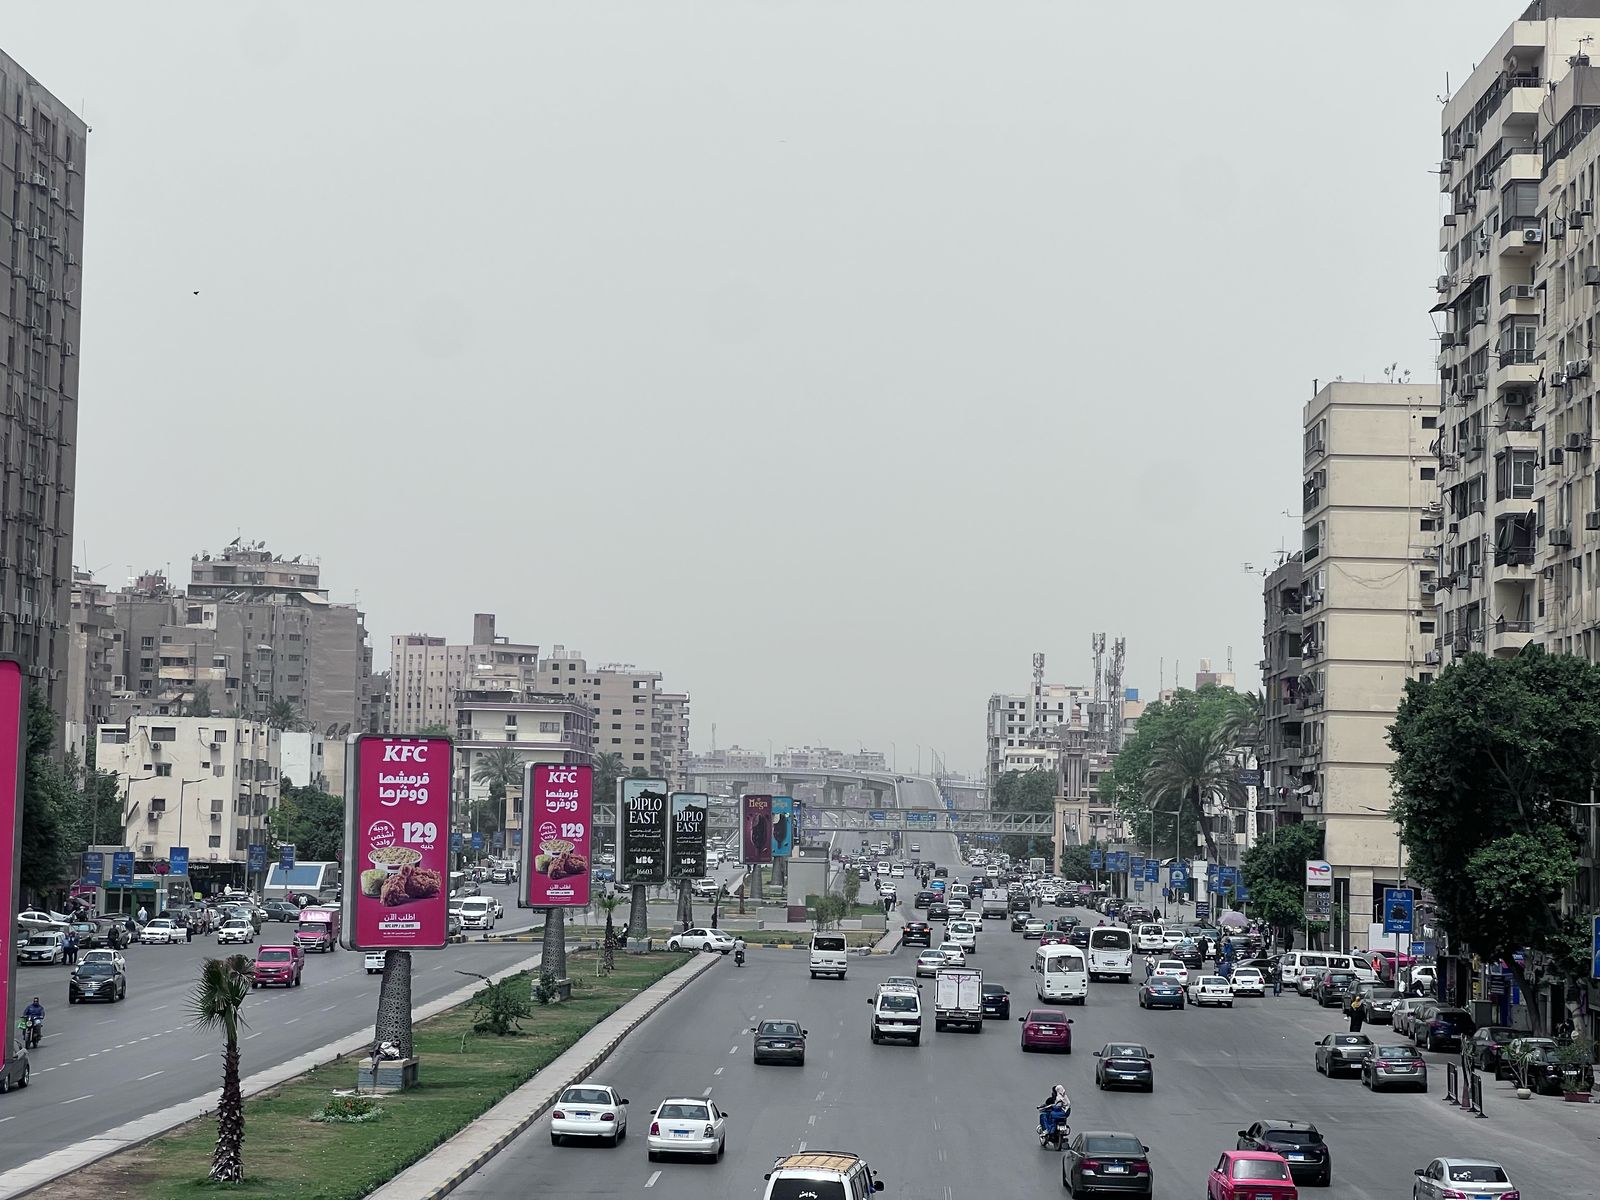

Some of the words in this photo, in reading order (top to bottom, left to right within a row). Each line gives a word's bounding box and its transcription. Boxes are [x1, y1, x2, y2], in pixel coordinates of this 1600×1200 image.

[383, 745, 428, 762] KFC
[379, 770, 430, 787] قرمشها
[548, 771, 577, 783] KFC
[546, 788, 579, 800] قرمشها
[630, 798, 662, 811] DIPLO
[677, 811, 704, 822] DIPLO
[373, 825, 388, 833] وجبة
[402, 822, 437, 843] 129
[561, 823, 584, 838] 129
[371, 831, 394, 841] لشخص
[384, 913, 397, 922] الآن
[398, 913, 416, 921] اطلب
